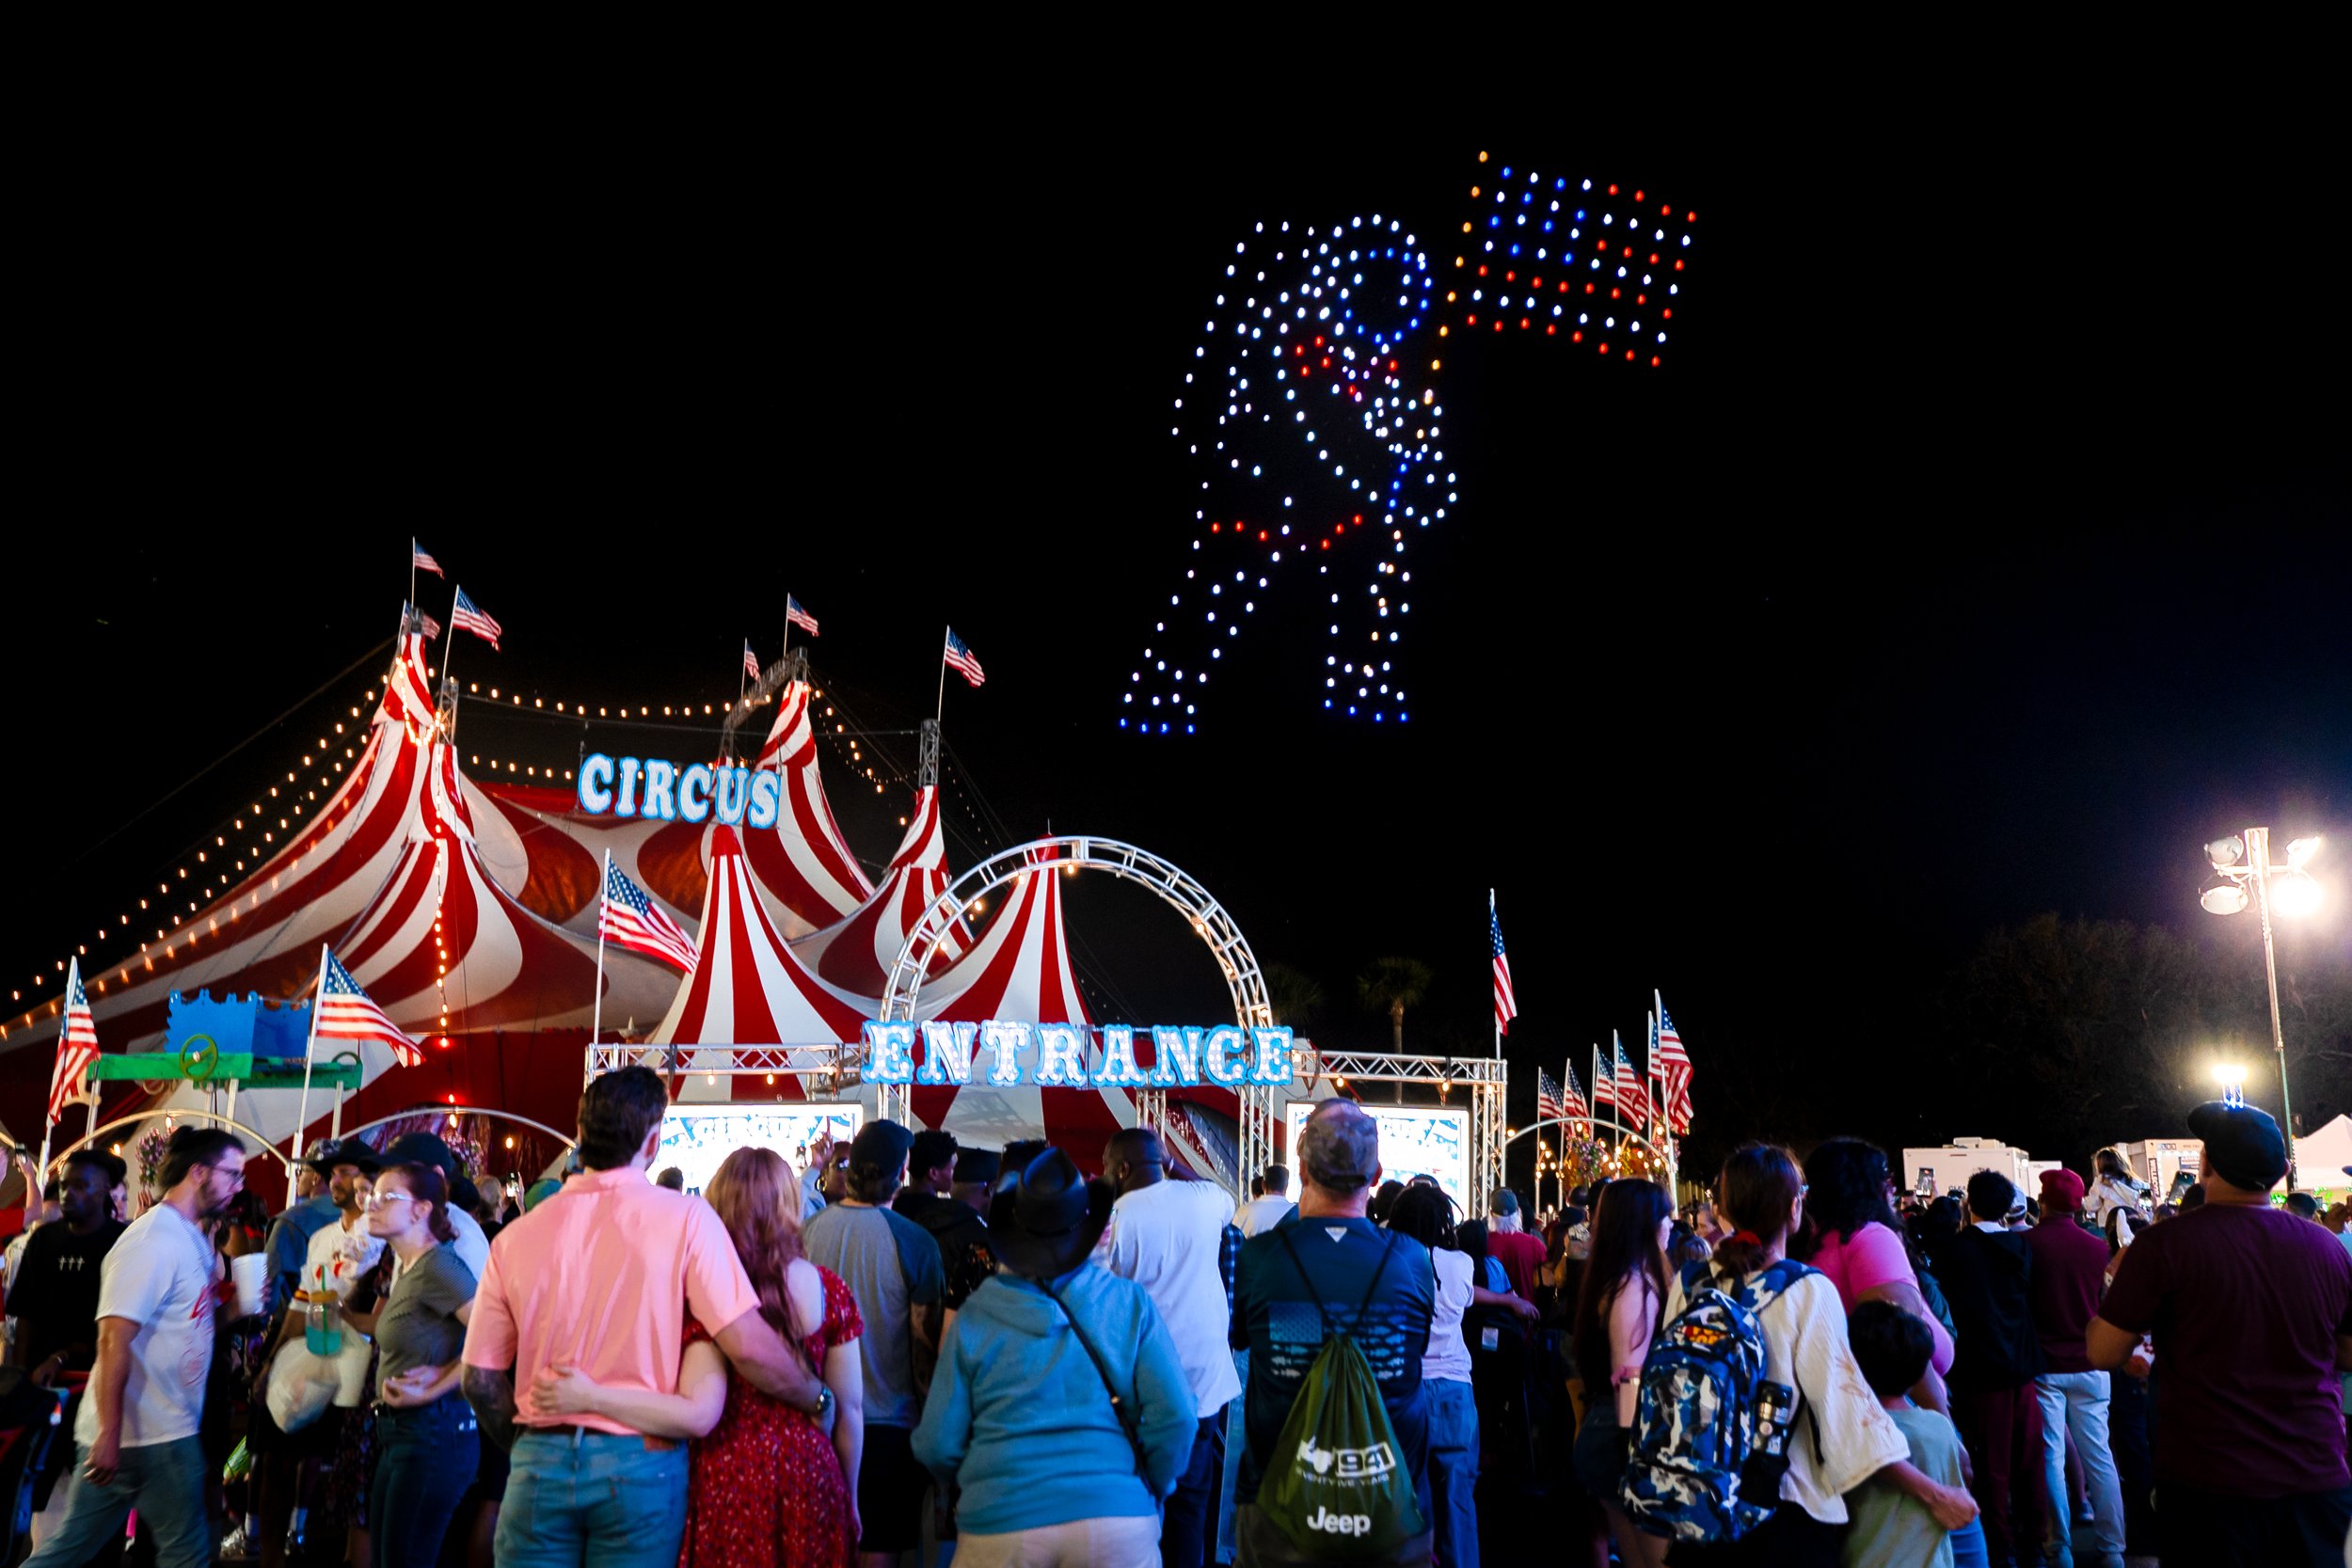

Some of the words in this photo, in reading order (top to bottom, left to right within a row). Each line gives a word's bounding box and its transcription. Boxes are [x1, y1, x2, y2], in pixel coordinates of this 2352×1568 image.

[579, 752, 782, 829] CIRCUS
[860, 1019, 1295, 1086] ENTRANCE
[1307, 1505, 1371, 1538] Jeep
